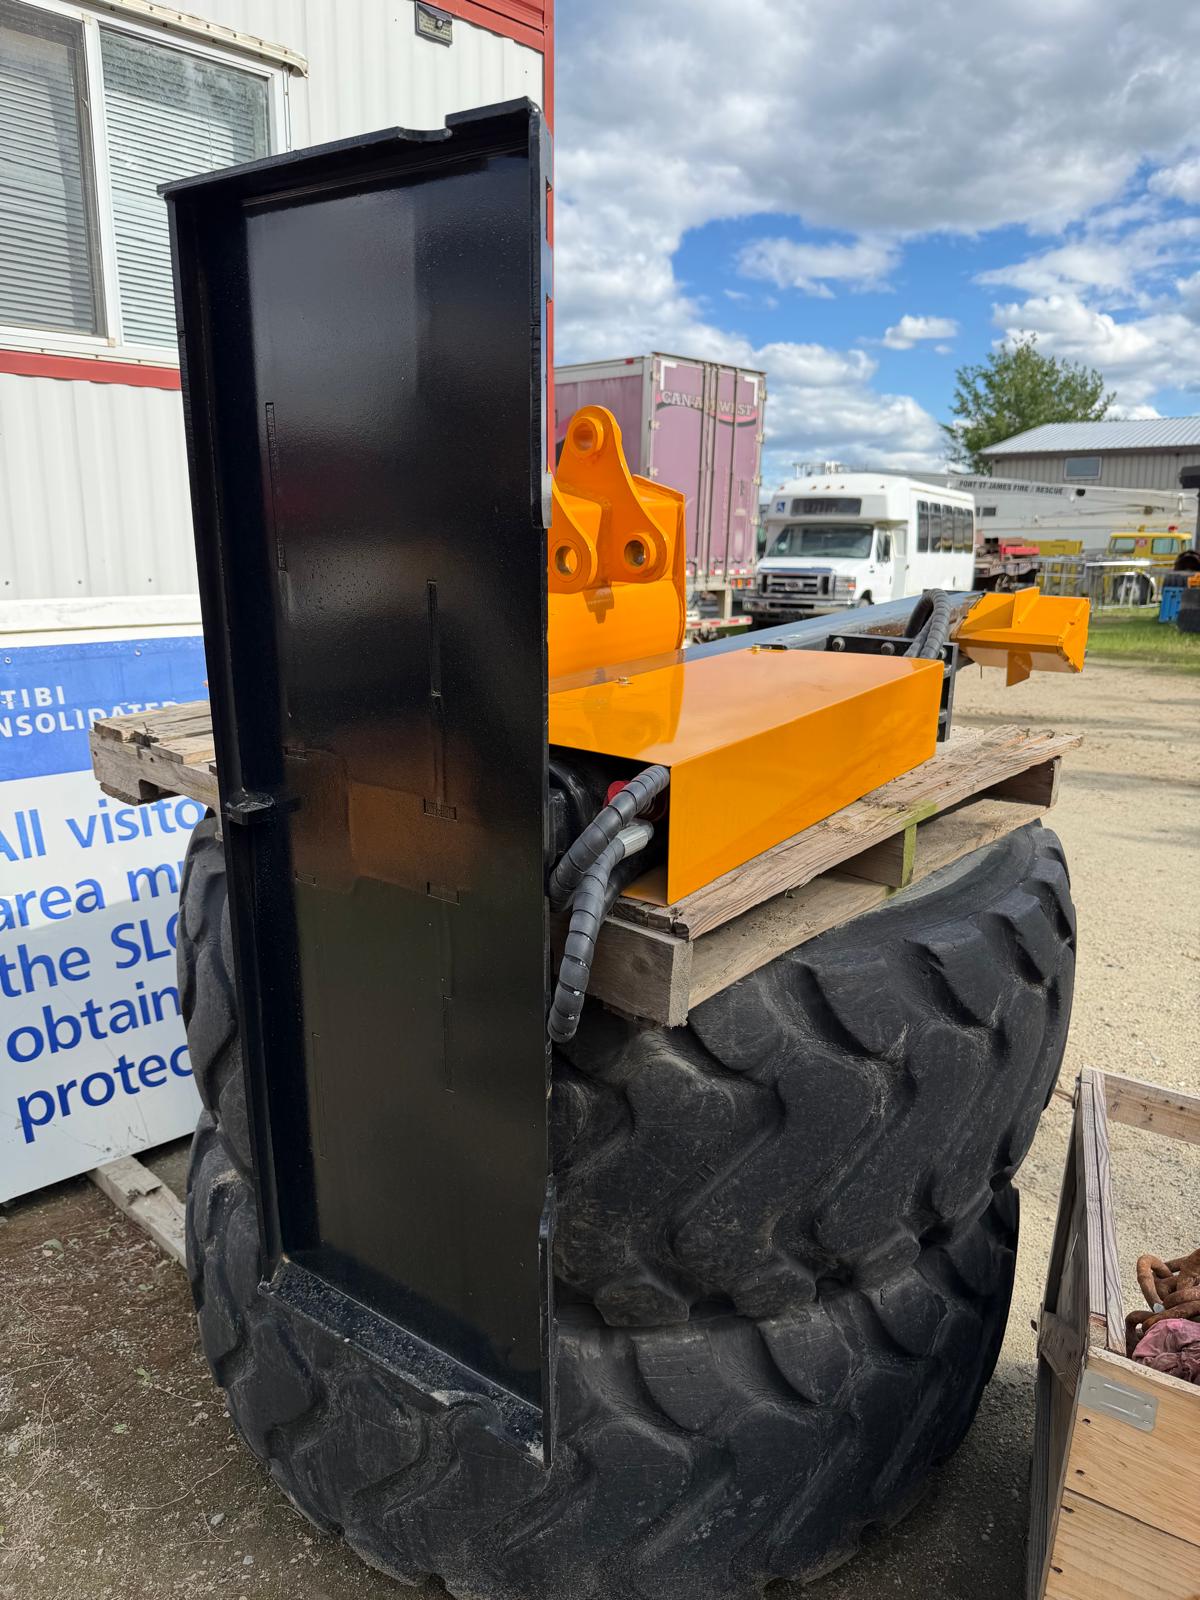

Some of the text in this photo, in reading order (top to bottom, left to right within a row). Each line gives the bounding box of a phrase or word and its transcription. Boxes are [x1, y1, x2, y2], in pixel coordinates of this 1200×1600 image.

[959, 480, 976, 488] FORT
[978, 481, 987, 489] ST
[988, 482, 1012, 491] JAMES
[1013, 484, 1029, 492] FIRE
[1036, 487, 1063, 496] RESCUE
[0, 944, 90, 998] the
